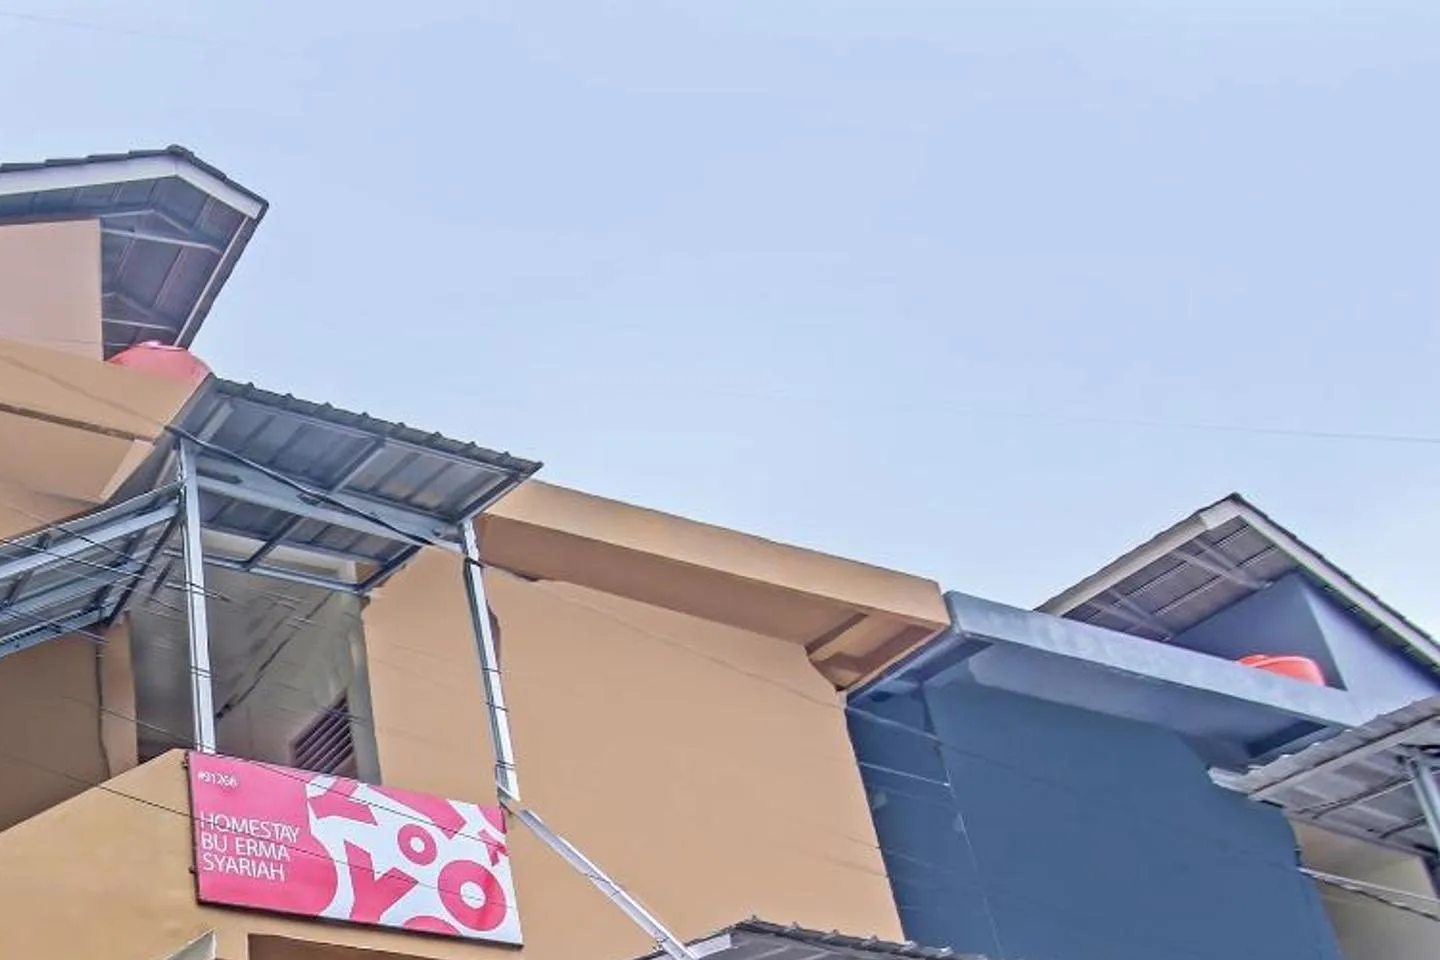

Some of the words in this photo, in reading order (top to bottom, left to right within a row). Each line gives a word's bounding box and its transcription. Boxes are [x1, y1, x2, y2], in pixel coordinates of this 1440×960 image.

[200, 811, 300, 844] HOMESTAY
[201, 831, 228, 853] BU
[235, 837, 291, 862] ERMA
[203, 852, 285, 882] SYARIAH
